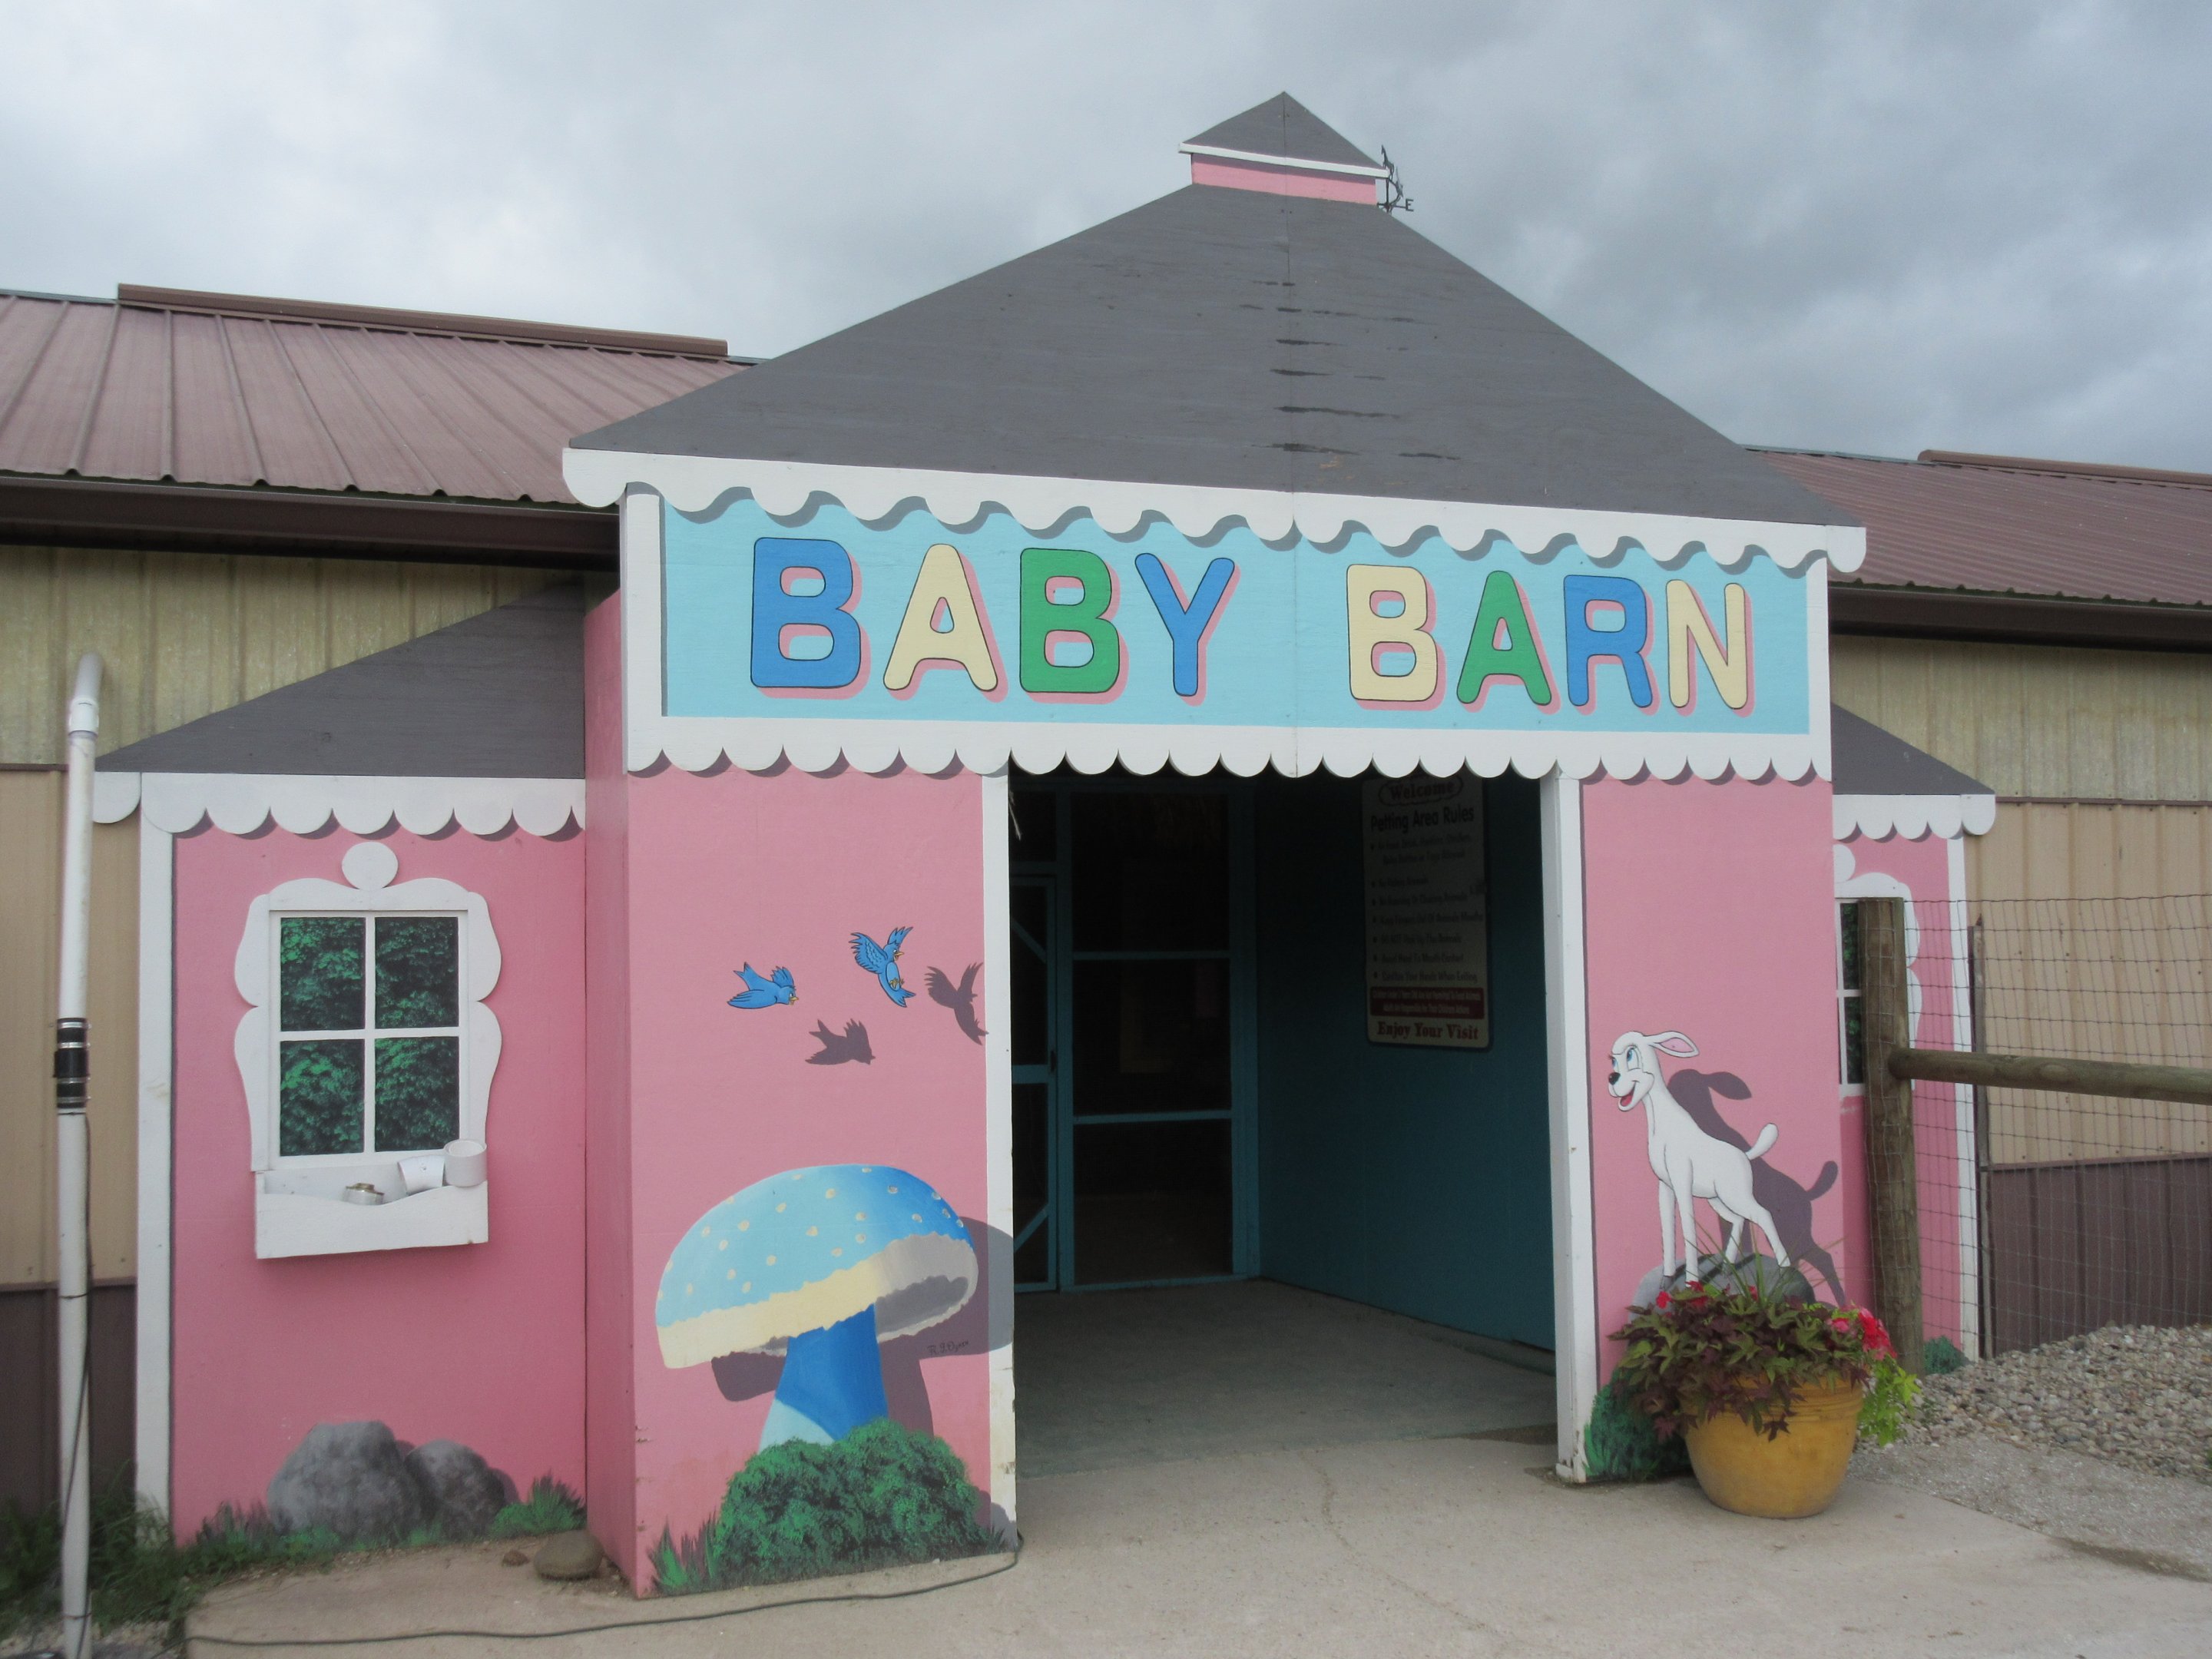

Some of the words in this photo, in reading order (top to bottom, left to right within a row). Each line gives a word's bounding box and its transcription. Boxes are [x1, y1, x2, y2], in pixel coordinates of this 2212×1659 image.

[747, 538, 1240, 705] BABY
[1346, 564, 1753, 717] BARN
[1388, 782, 1454, 800] Welcome
[1371, 813, 1409, 833] Petting
[1412, 810, 1439, 828] Area
[1444, 805, 1474, 824] Rules
[1377, 1021, 1411, 1038] Enjoy
[1414, 1022, 1443, 1038] Your
[1446, 1023, 1479, 1040] Visit
